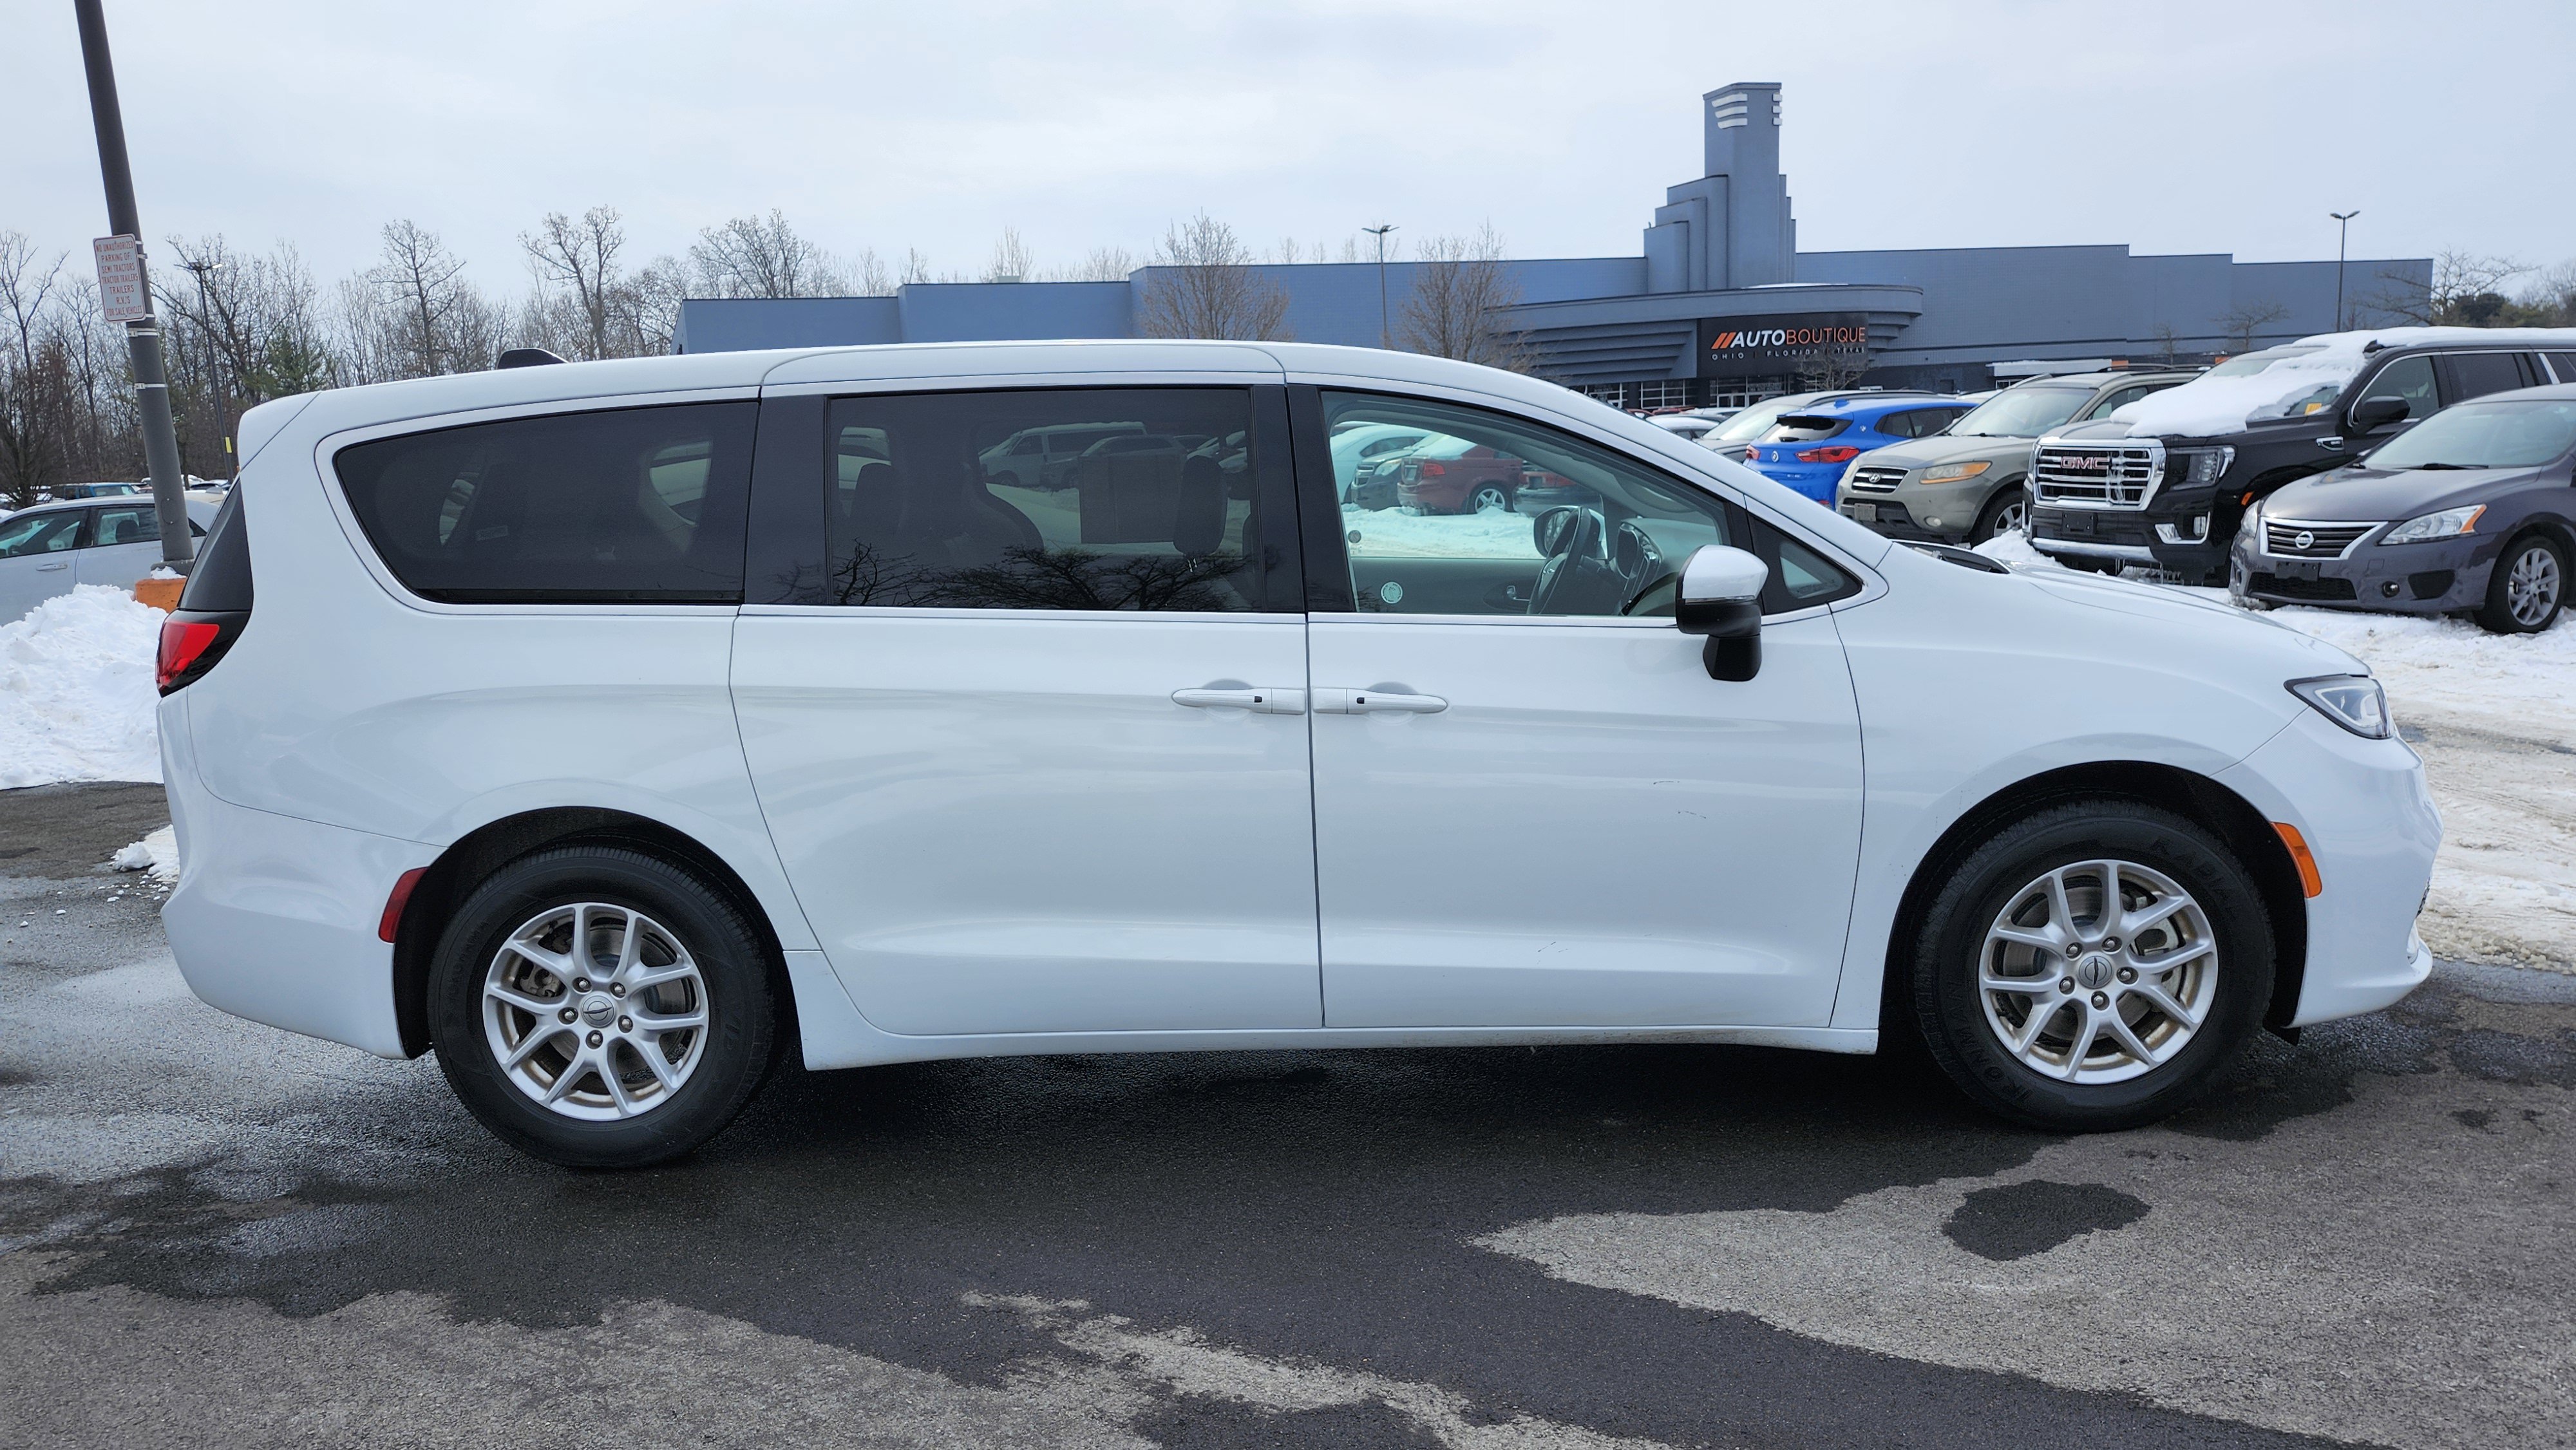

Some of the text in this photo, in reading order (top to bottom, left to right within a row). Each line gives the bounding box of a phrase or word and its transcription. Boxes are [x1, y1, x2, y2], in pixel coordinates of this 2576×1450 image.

[101, 253, 122, 262] PARKING
[113, 263, 135, 272] TRACTORS
[102, 274, 138, 284] TRACTOR TRAILERS
[109, 285, 134, 294] TRAILERS
[125, 305, 142, 314] VEHICLES
[1767, 349, 1817, 357] FLORIDA
[2061, 457, 2110, 469] GMC
